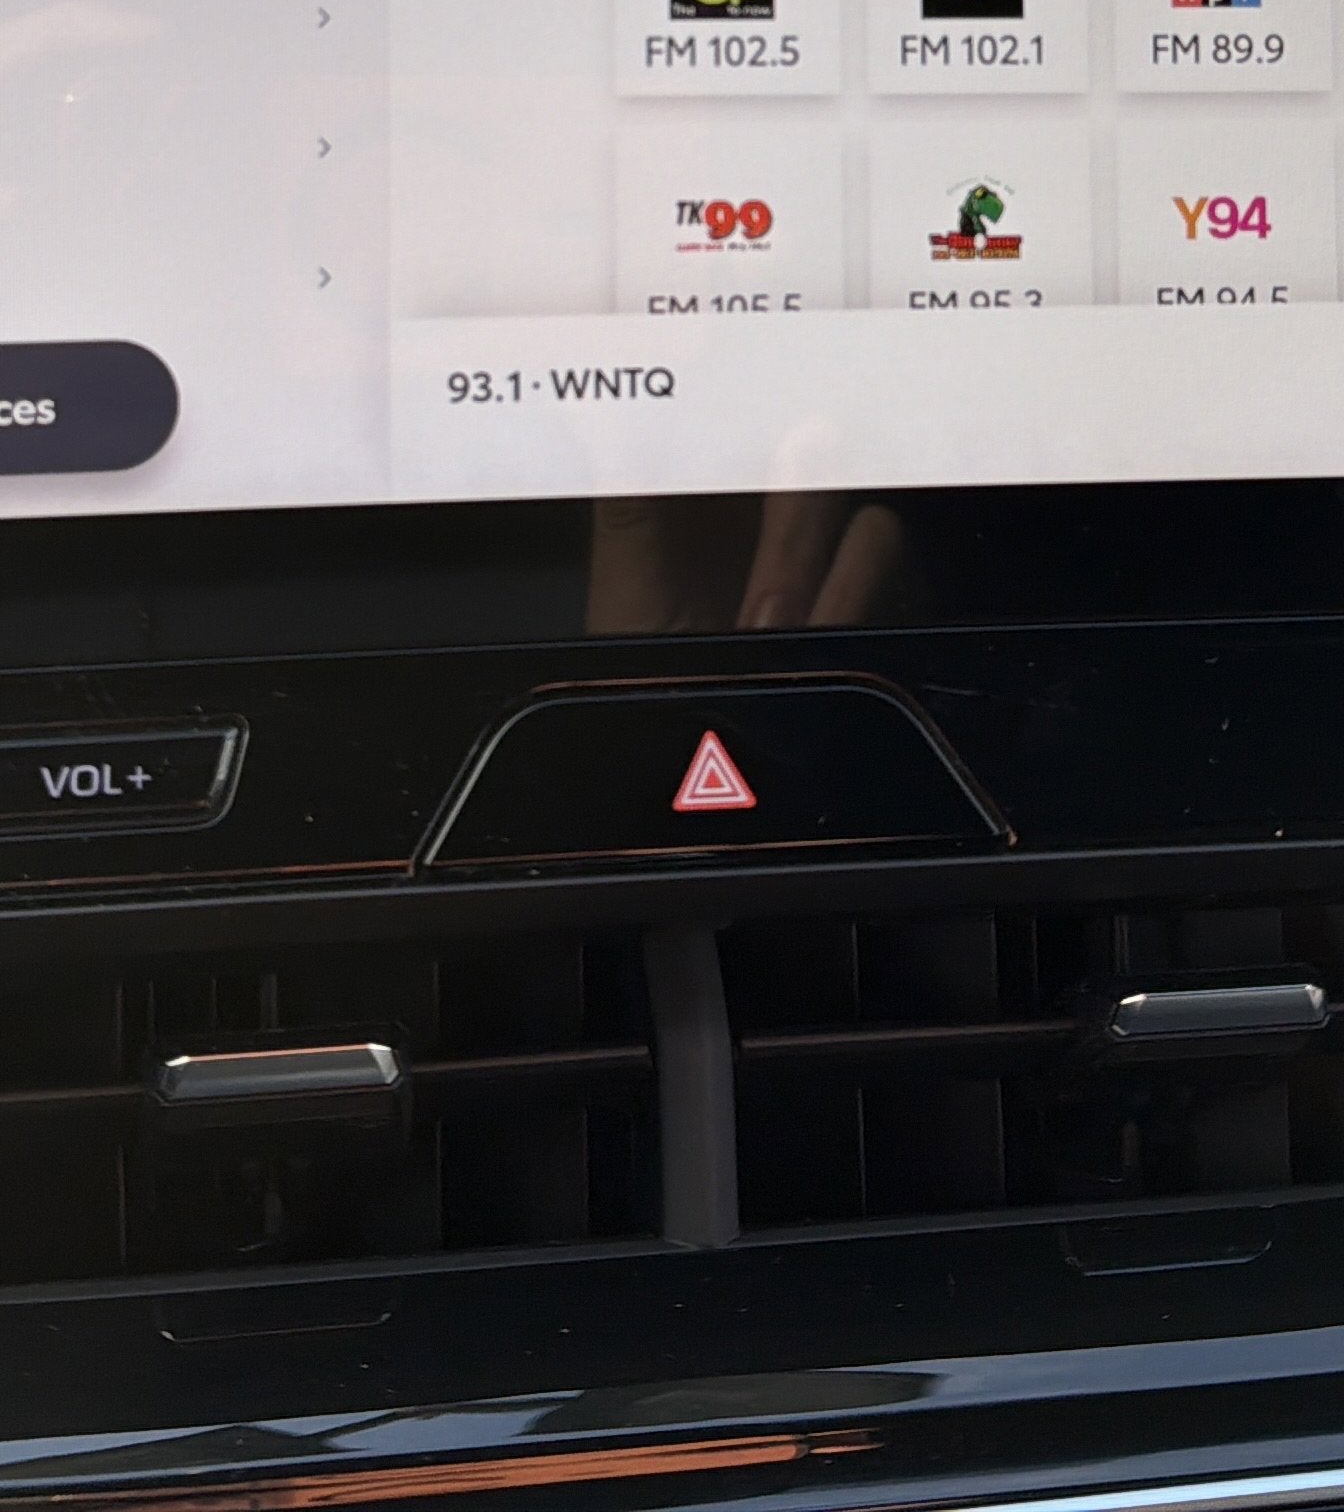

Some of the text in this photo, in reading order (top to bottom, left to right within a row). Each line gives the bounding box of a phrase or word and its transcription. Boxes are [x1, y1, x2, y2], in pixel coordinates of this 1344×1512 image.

[645, 35, 800, 68] FM 102.5
[900, 34, 1044, 66] FM 102.1
[1152, 33, 1285, 65] FM 89.9
[1172, 195, 1272, 240] Y94
[447, 366, 675, 403] 93.1 WNTQ
